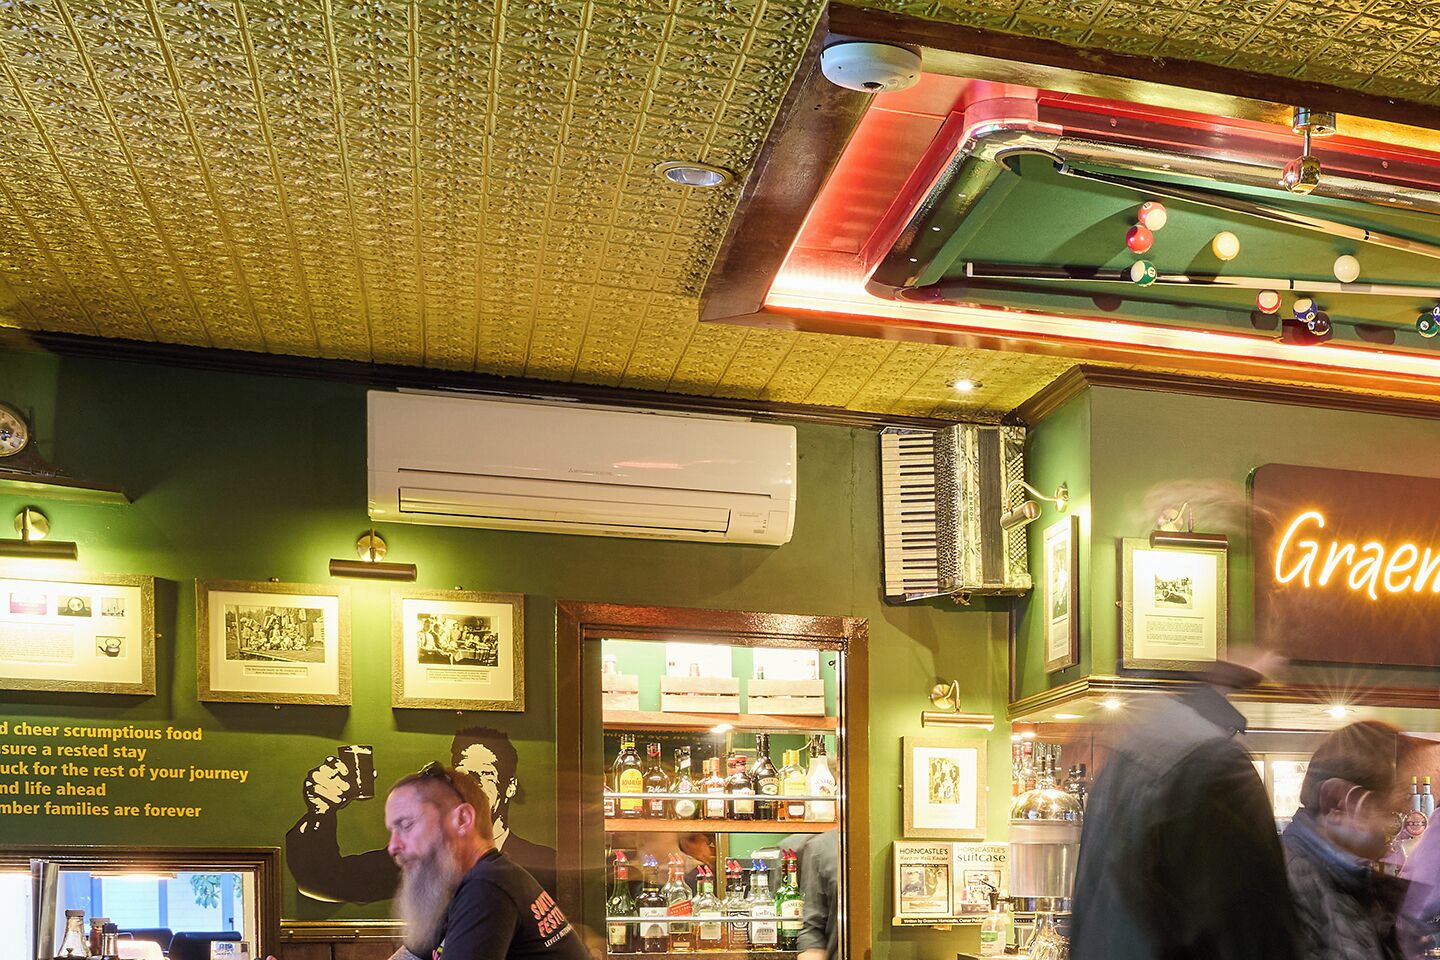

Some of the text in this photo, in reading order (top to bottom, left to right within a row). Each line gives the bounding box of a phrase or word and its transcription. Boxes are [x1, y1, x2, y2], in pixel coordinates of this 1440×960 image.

[14, 722, 59, 737] cheer
[64, 726, 162, 741] scrumptious
[166, 727, 202, 740] food
[42, 745, 51, 756] a
[57, 744, 108, 758] rested
[113, 746, 147, 761] stay
[33, 762, 57, 775] for
[61, 763, 88, 776] the
[93, 765, 124, 777] rest
[129, 765, 145, 778] of
[150, 767, 186, 781] your
[189, 766, 249, 783] journey
[24, 781, 51, 795] life
[56, 782, 106, 796] ahead
[44, 801, 110, 816] families
[114, 805, 140, 817] are
[144, 803, 202, 817] forever
[900, 847, 949, 855] HORNCASTLE'S
[957, 853, 1006, 862] suitcase
